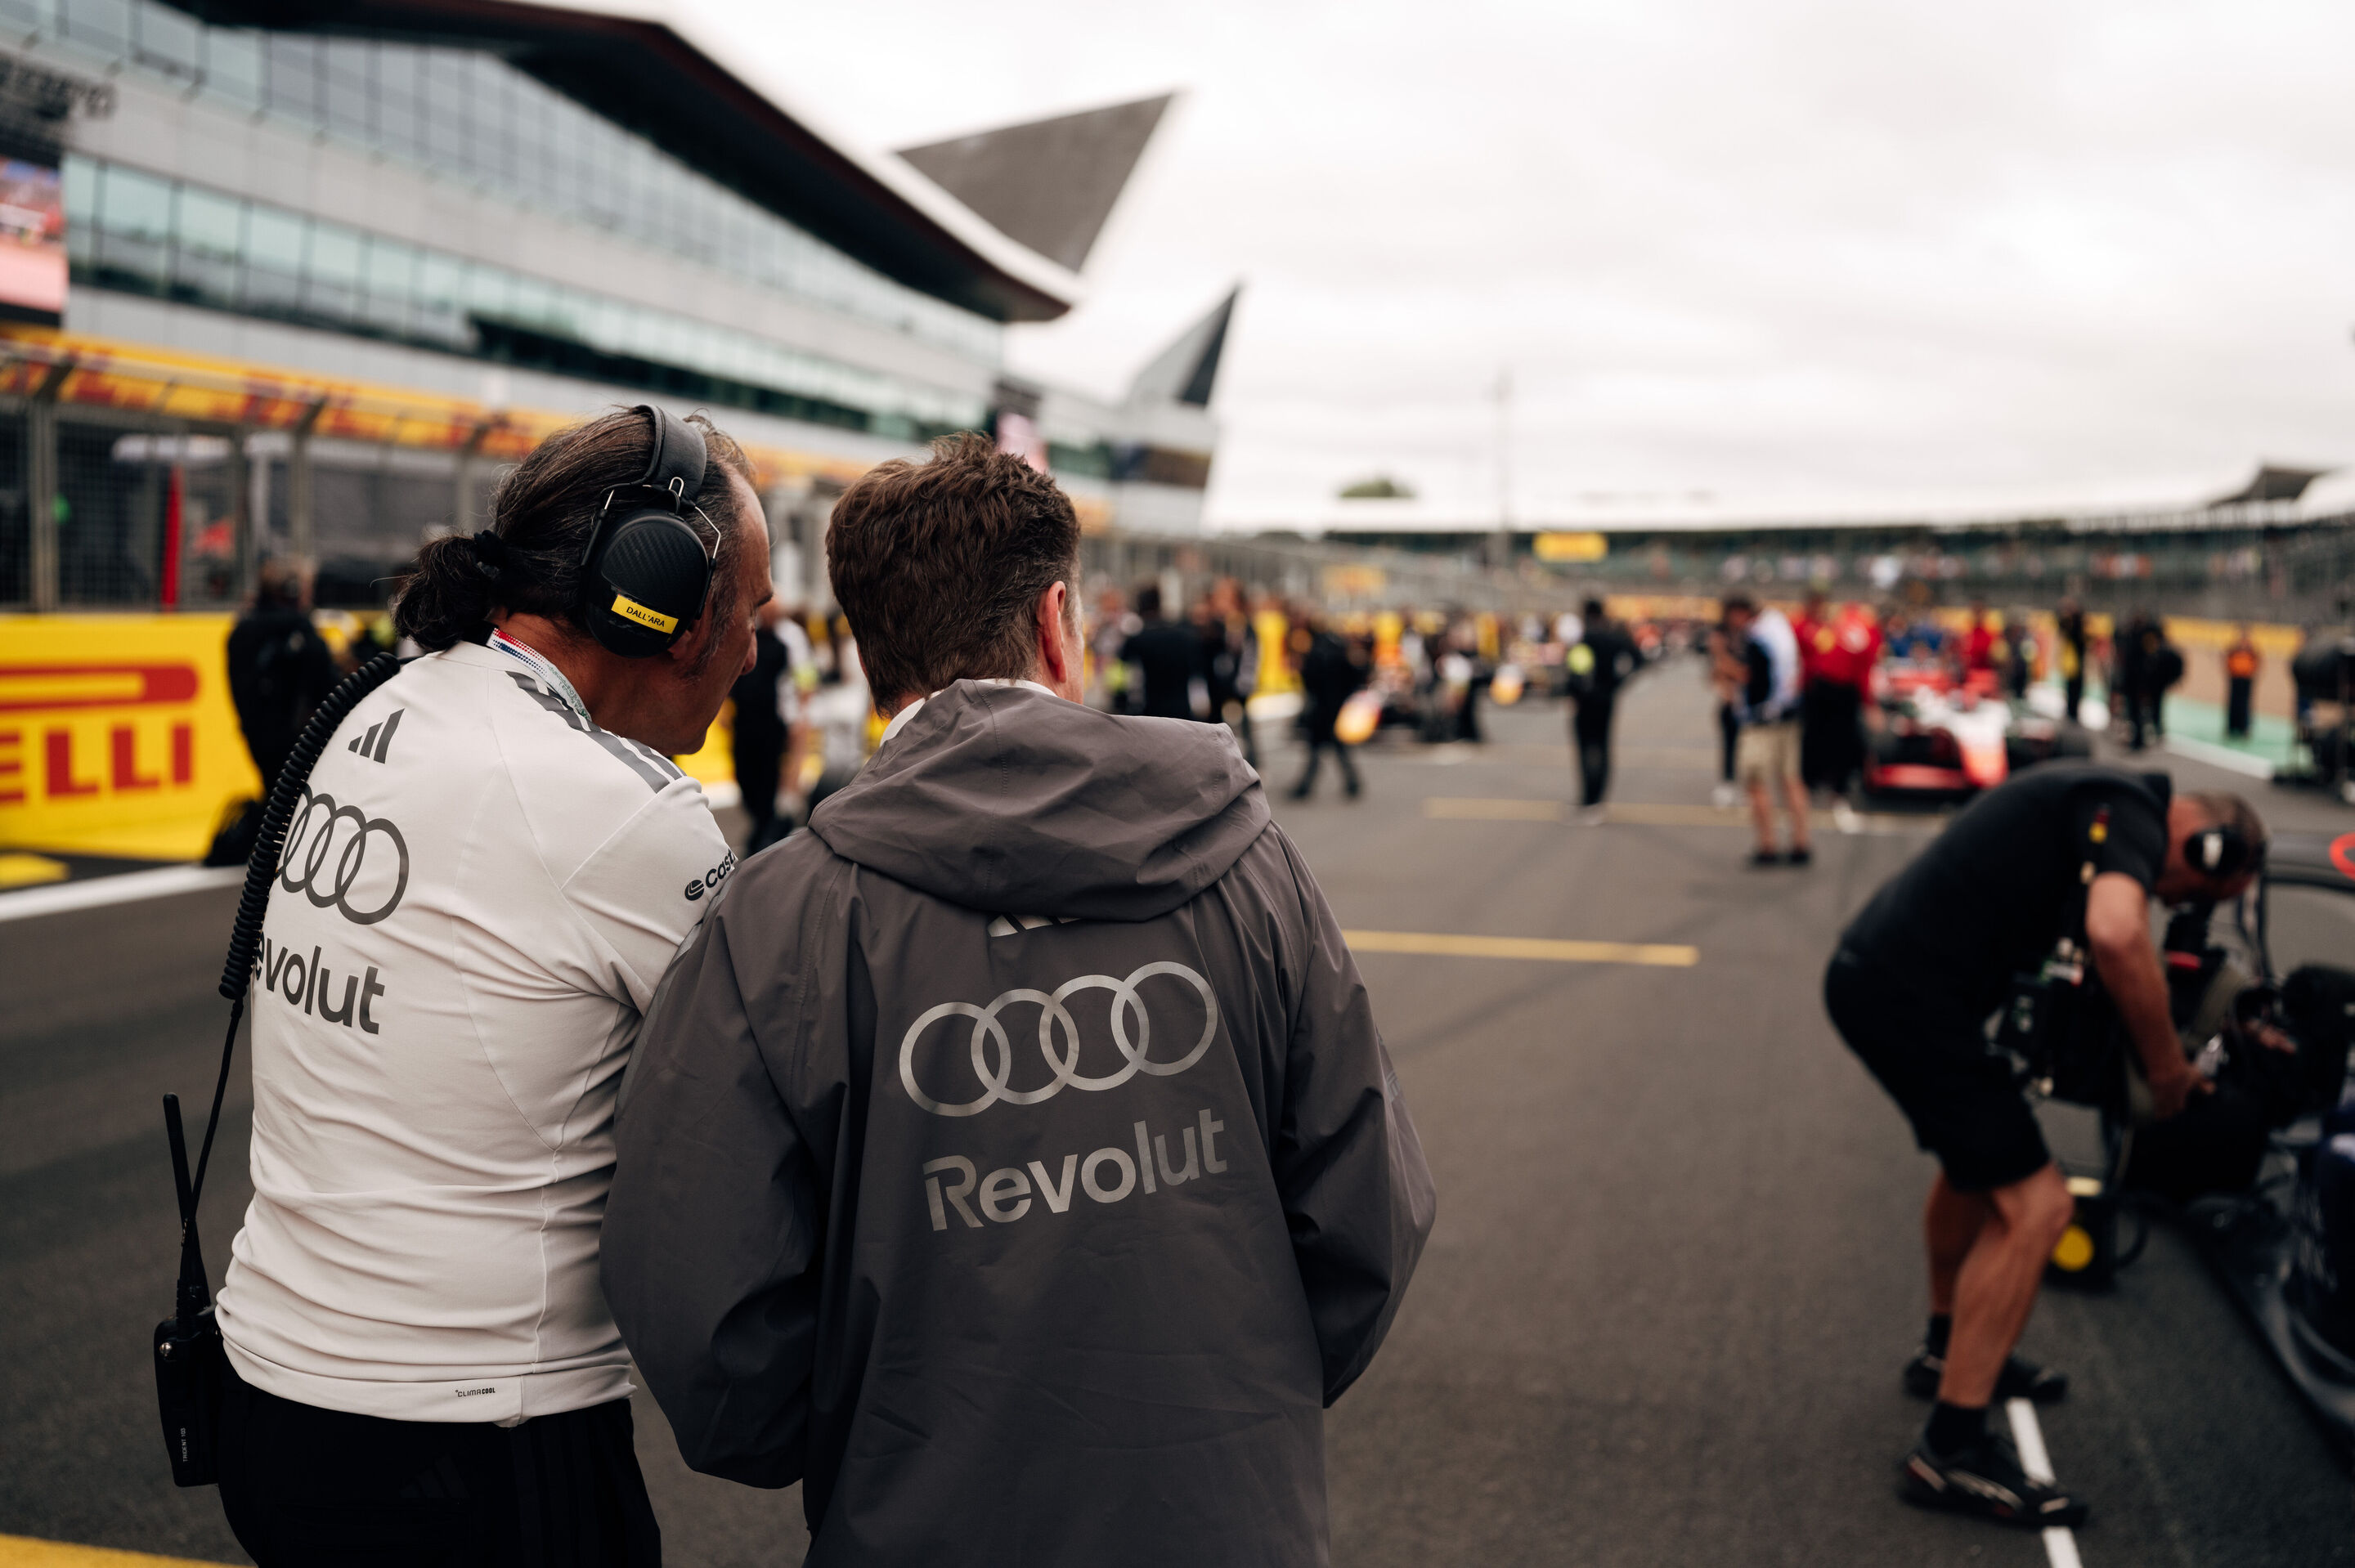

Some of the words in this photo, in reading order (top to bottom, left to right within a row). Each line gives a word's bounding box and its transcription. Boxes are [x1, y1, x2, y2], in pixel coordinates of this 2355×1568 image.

[626, 607, 666, 628] DALL'ARA
[255, 931, 385, 1035] evolut
[922, 1108, 1227, 1231] Revolut
